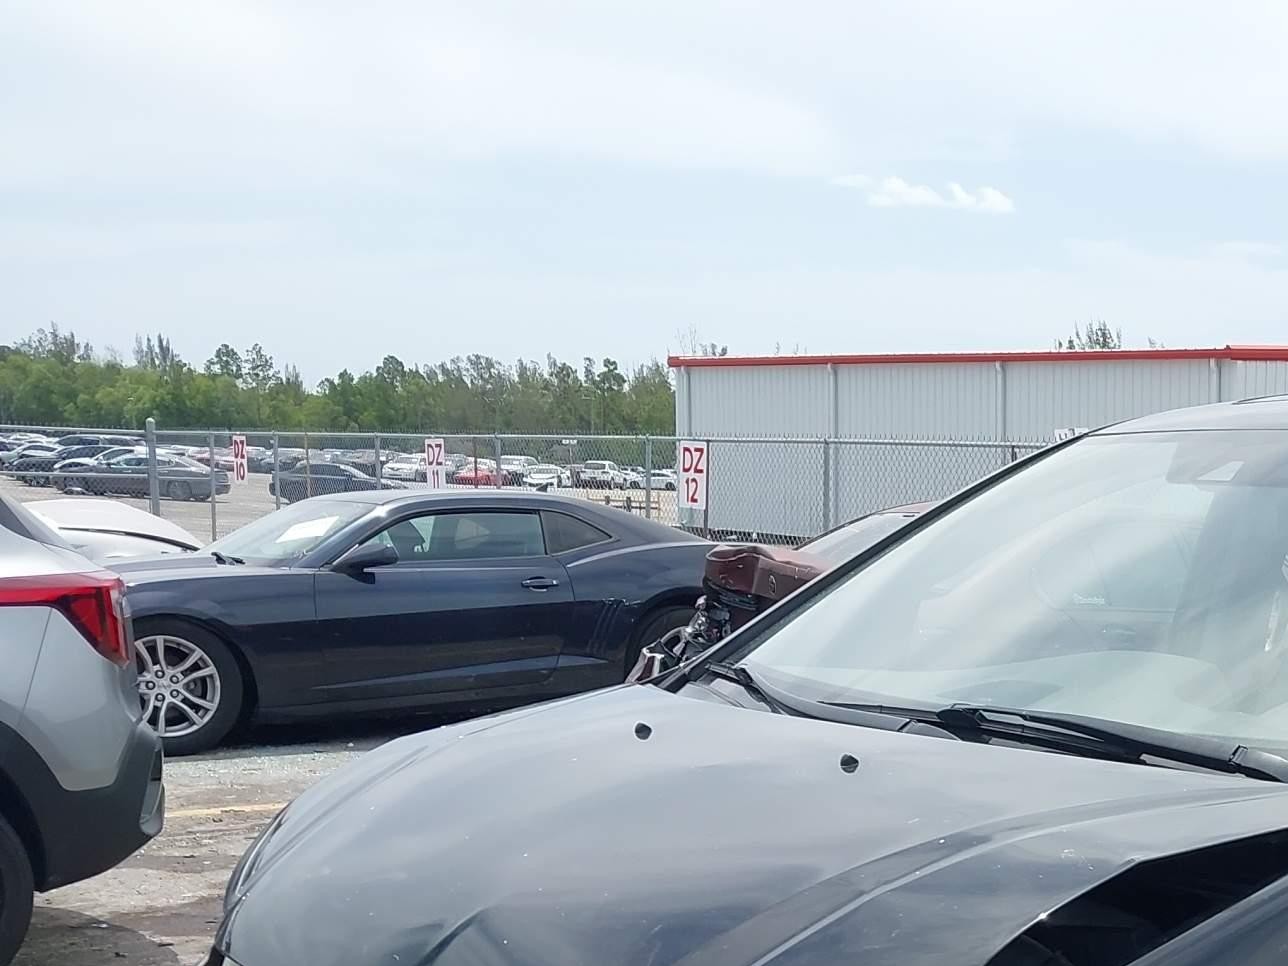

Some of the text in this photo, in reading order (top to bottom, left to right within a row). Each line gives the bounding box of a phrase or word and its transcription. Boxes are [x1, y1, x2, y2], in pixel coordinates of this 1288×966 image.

[234, 440, 245, 459] DZ
[427, 443, 443, 466] DZ
[682, 446, 705, 474] DZ
[236, 461, 245, 480] 10
[685, 477, 699, 504] 12
